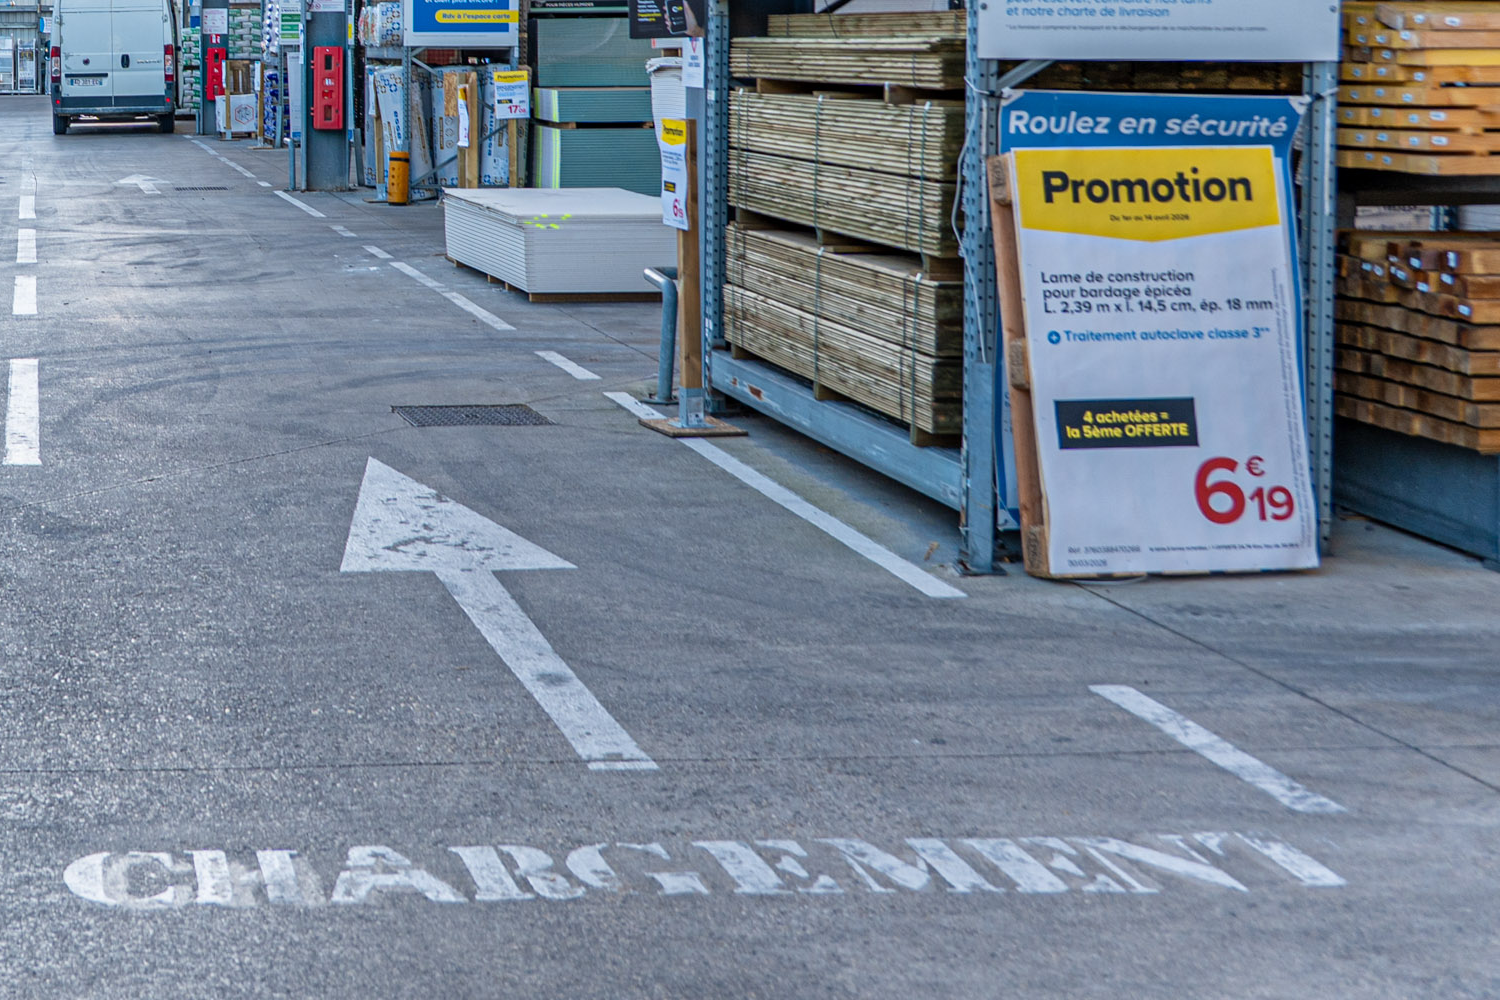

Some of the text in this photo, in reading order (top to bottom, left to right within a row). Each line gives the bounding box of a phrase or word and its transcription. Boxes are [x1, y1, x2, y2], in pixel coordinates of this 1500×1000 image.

[463, 12, 492, 21] l'espace
[1006, 6, 1170, 18] et notre charte de livraison
[1008, 110, 1289, 139] Roulez en sécurité
[1042, 166, 1253, 204] Promotion
[1041, 268, 1195, 284] Lame de construction
[1043, 284, 1192, 301] pour bardage épicéa
[1044, 301, 1057, 314] L.
[1060, 301, 1092, 314] 2,39
[1096, 303, 1110, 312] m
[1114, 303, 1124, 312] x
[1138, 300, 1166, 314] 14,5
[1170, 302, 1196, 314] cm,
[1200, 299, 1222, 315] ép.
[1227, 298, 1242, 310] 18
[1245, 301, 1273, 311] mm
[1064, 329, 1137, 343] Traitement
[1140, 328, 1205, 341] autoclave
[1208, 327, 1249, 340] classe
[1083, 409, 1158, 424] 4 achetées
[1066, 423, 1190, 439] la 5ème OFFERTE
[63, 832, 1347, 905] CHARGEMENT
